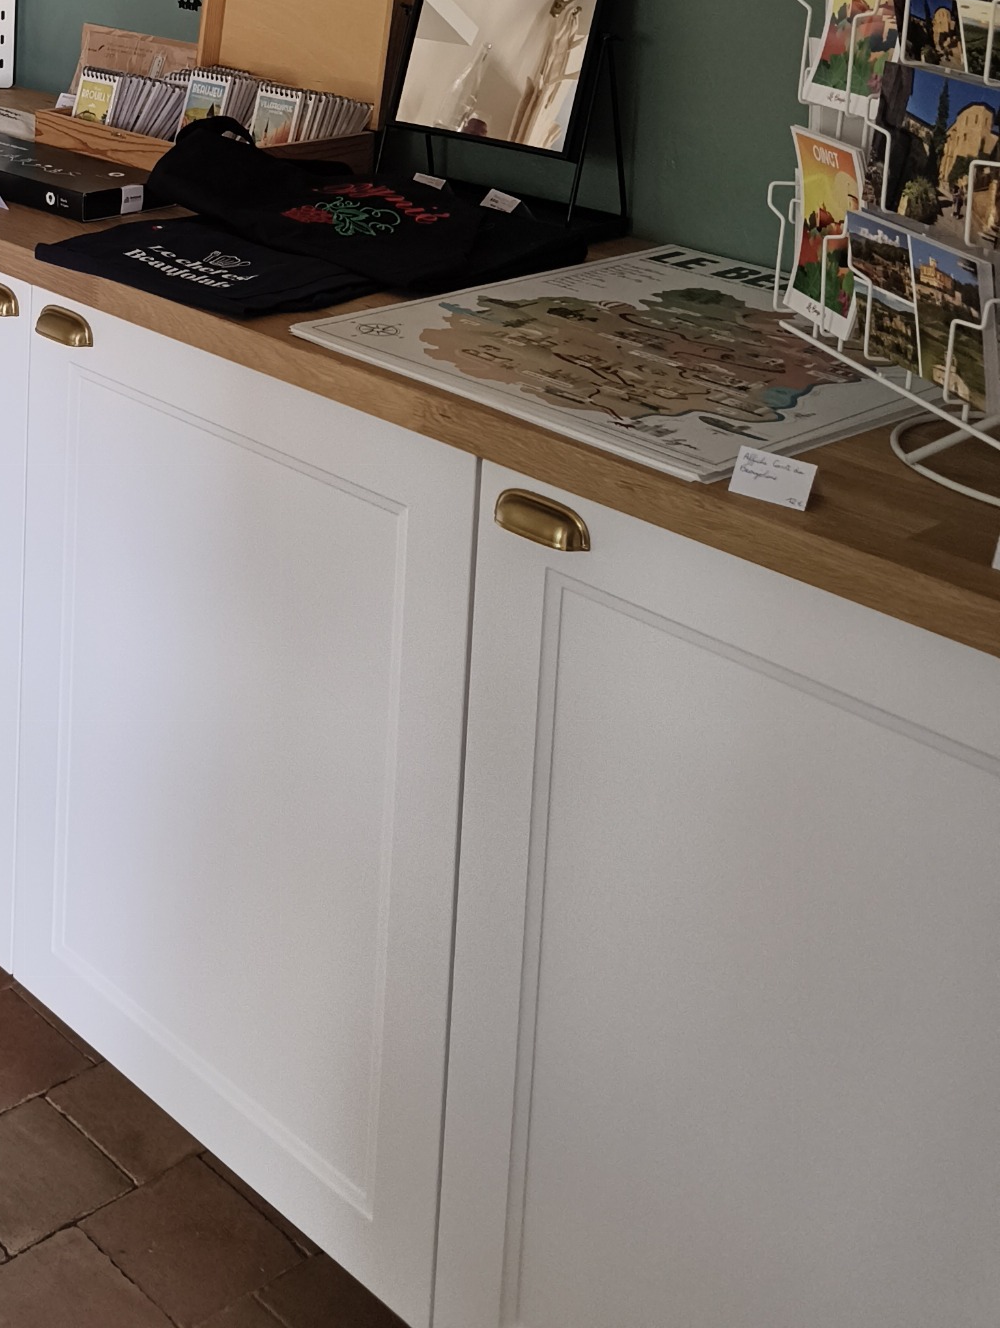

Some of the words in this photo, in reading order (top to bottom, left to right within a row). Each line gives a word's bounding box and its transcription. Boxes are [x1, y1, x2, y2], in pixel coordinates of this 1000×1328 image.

[81, 88, 111, 103] BROUILLY
[192, 83, 223, 99] BEAUJEU
[812, 144, 840, 169] OINGT
[148, 245, 176, 258] Le
[176, 258, 228, 275] chef
[647, 251, 720, 270] LE
